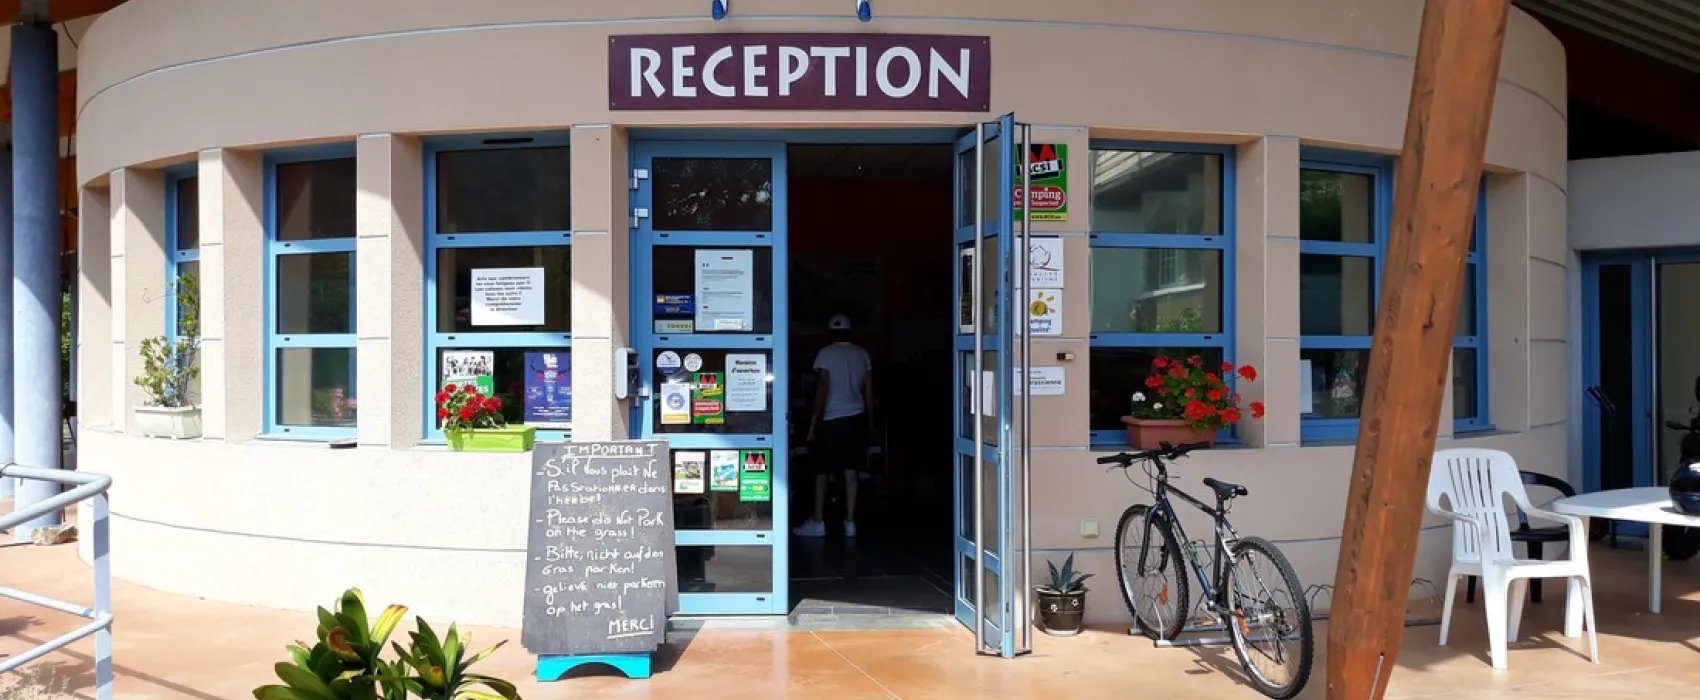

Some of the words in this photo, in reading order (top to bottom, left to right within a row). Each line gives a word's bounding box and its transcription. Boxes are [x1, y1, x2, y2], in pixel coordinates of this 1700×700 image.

[629, 44, 971, 99] RECEPTION
[563, 444, 659, 456] IMPORTANT
[638, 481, 666, 494] dans
[546, 508, 589, 526] Please
[591, 512, 612, 524] do
[546, 526, 562, 538] on
[567, 526, 586, 538] the
[586, 548, 620, 560] nicht
[546, 607, 566, 618] op
[571, 602, 588, 612] het
